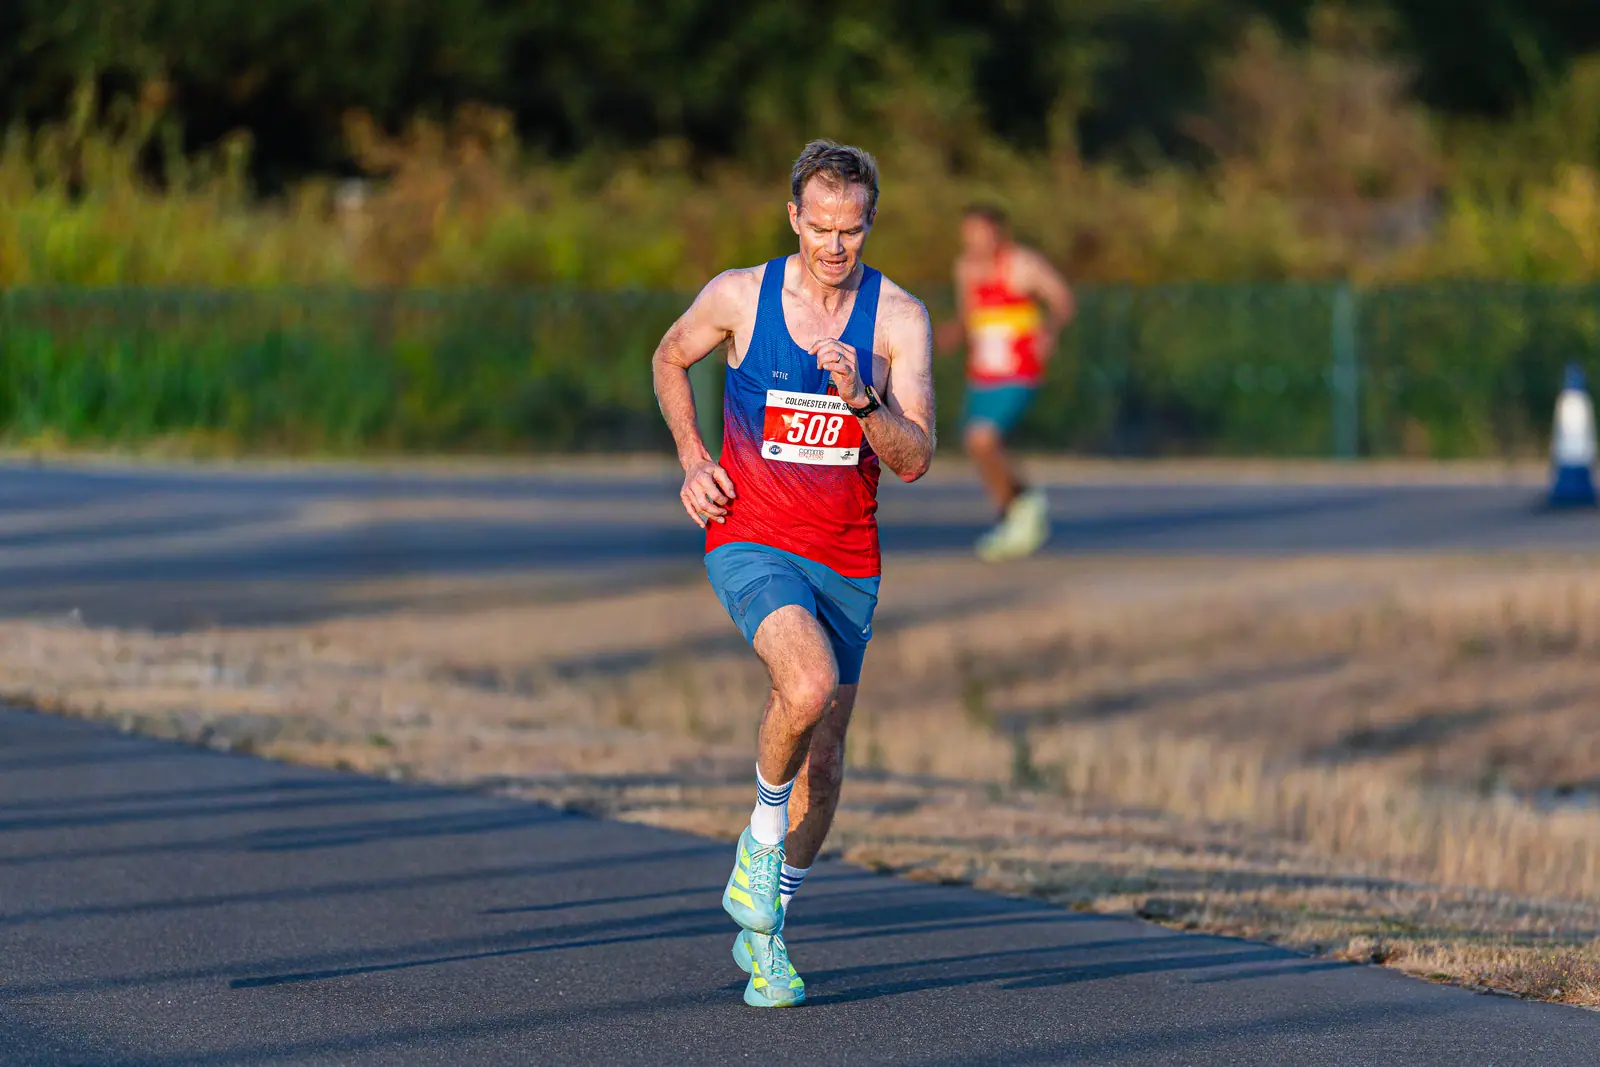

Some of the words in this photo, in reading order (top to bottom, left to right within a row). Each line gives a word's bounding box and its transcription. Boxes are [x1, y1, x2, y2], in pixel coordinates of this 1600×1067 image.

[785, 397, 828, 409] COLCHESTER
[828, 401, 841, 410] FNR
[787, 412, 844, 446] 508
